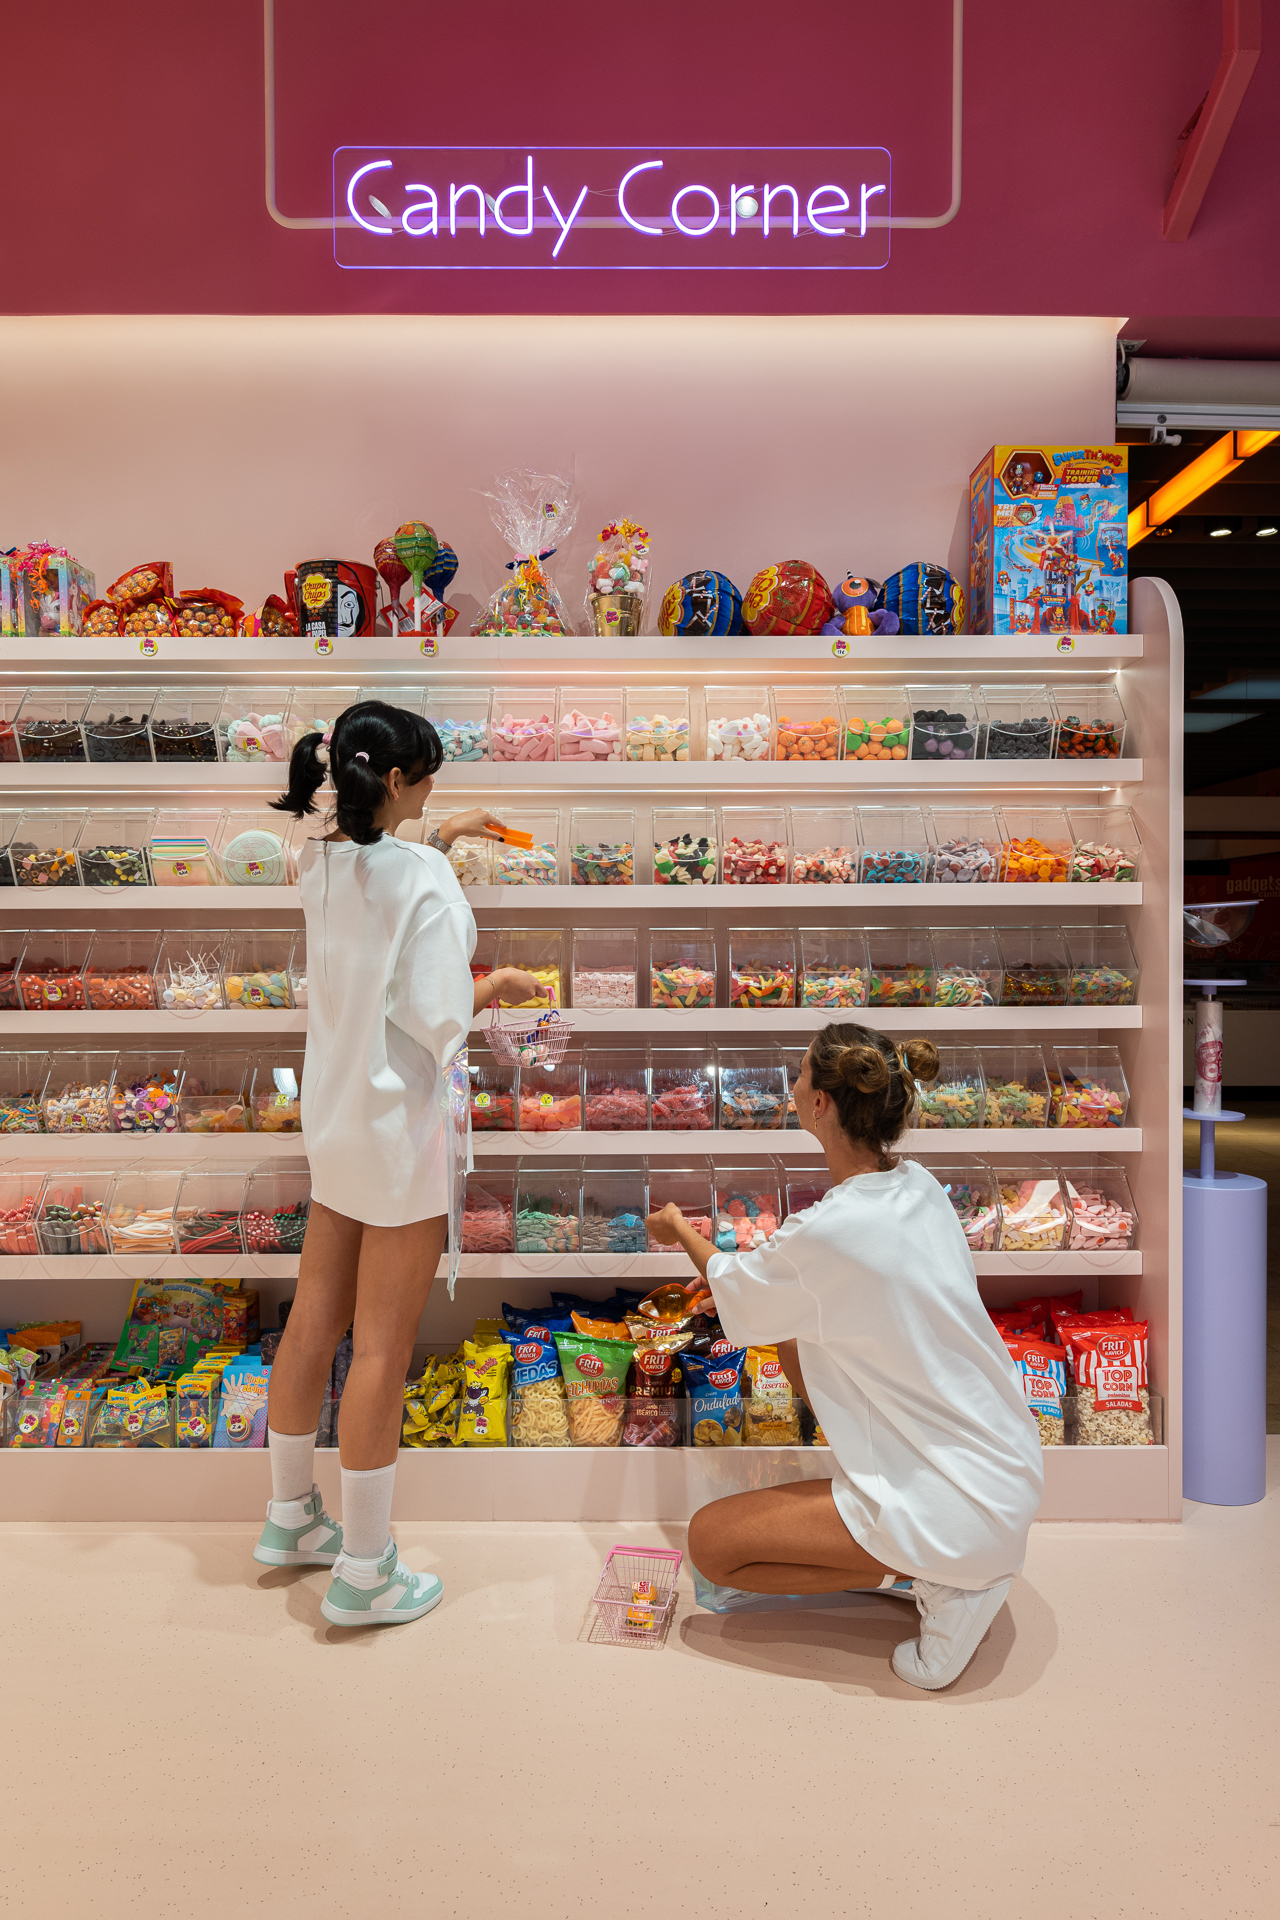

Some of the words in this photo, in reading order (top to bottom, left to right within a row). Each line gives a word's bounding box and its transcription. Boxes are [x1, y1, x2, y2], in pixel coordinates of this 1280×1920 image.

[347, 154, 588, 258] Candy
[618, 160, 886, 237] Corner
[304, 582, 327, 591] Chupa
[304, 591, 326, 600] Chups
[305, 623, 311, 631] LA
[311, 622, 326, 630] CASA
[1226, 876, 1280, 894] gadgets
[192, 1288, 212, 1300] PACK
[527, 1331, 547, 1339] FRIT
[651, 1329, 671, 1338] FRIT
[1102, 1341, 1126, 1351] FRIT
[644, 1355, 667, 1365] FRIT
[1027, 1354, 1045, 1364] FRIT
[579, 1359, 601, 1370] FRIT
[763, 1364, 780, 1372] FRIT
[244, 1373, 267, 1384] Finger
[1102, 1370, 1132, 1382] TOP
[755, 1379, 789, 1389] Caseras
[1029, 1378, 1052, 1390] TOP
[1102, 1382, 1133, 1392] CORN
[242, 1385, 266, 1395] string
[630, 1386, 679, 1396] PREMIUM
[1031, 1390, 1055, 1398] CORN
[636, 1407, 658, 1416] IBÉRICO
